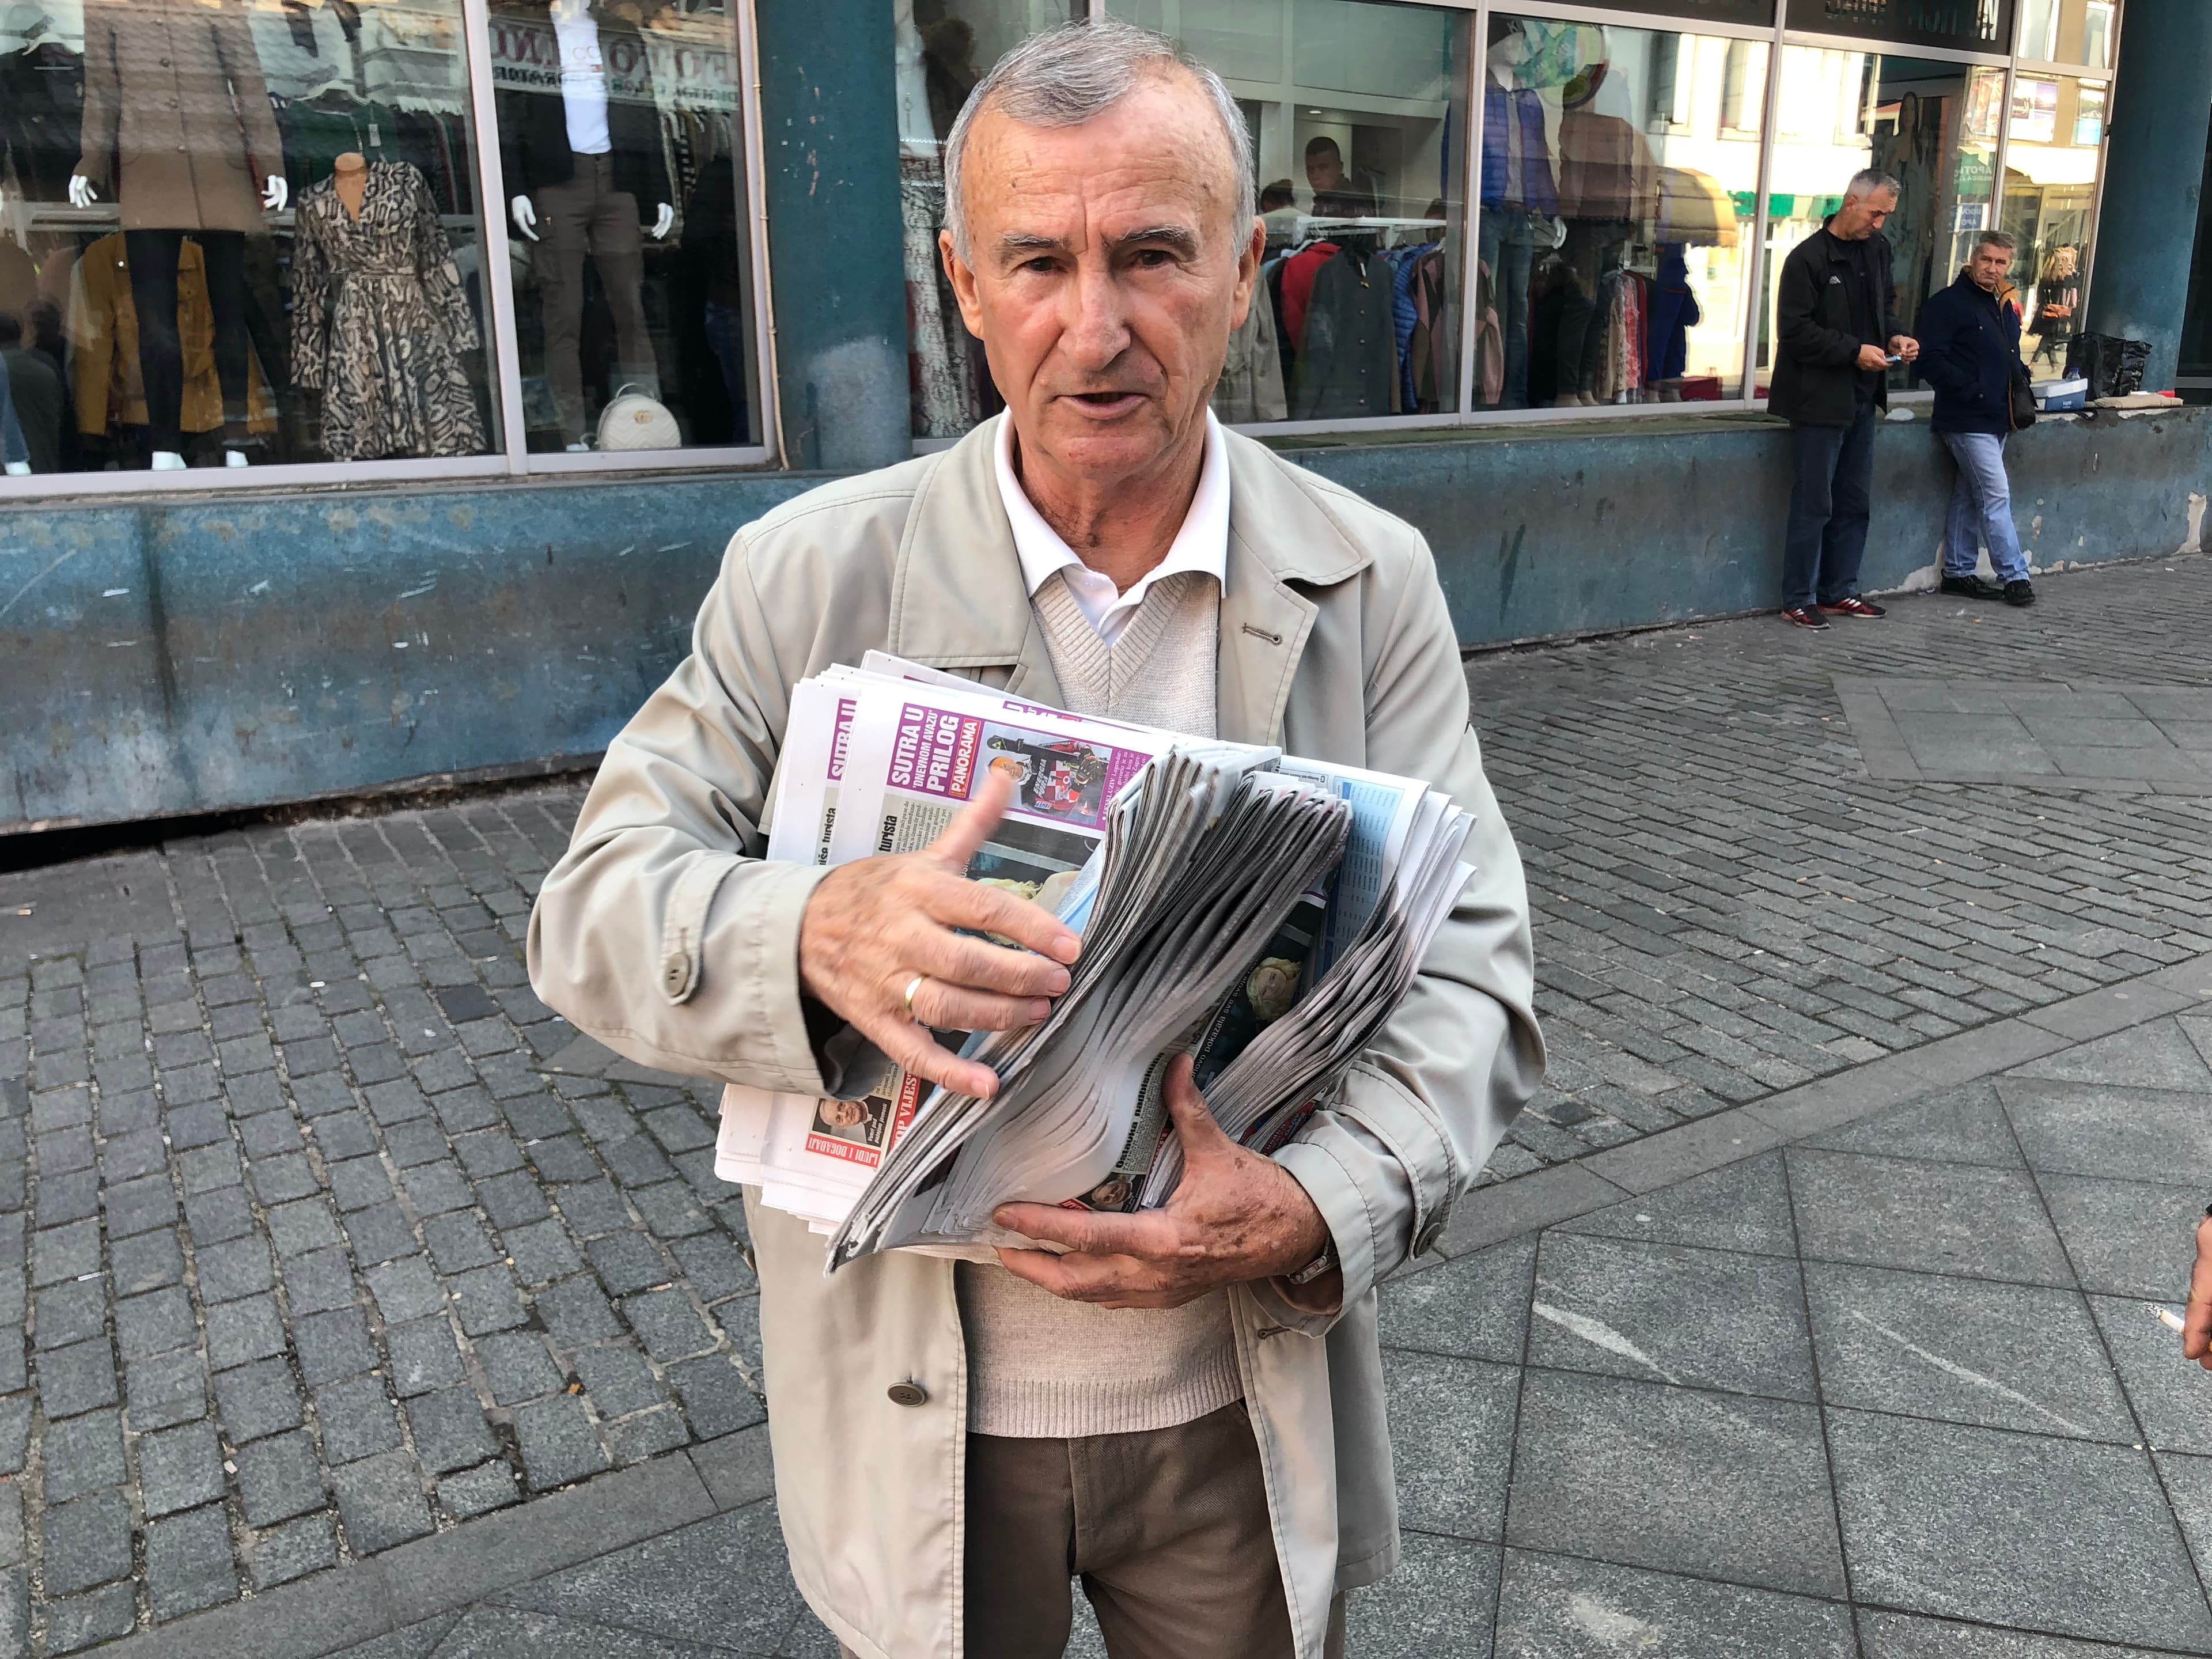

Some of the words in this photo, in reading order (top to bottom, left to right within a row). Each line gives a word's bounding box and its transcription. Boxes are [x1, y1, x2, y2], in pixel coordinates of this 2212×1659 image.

[904, 707, 924, 722] U
[891, 726, 921, 786] SUTRA
[927, 714, 960, 792] PRILOG
[951, 721, 978, 792] PANORAMA
[1033, 759, 1047, 794] ENERGIA
[1038, 775, 1048, 798] PURA
[1103, 778, 1115, 815] EKSKLUZIV
[932, 807, 942, 825] godinu
[878, 815, 897, 853] turista
[902, 824, 911, 848] milijarde
[1204, 1015, 1226, 1053] pokazala
[878, 1103, 889, 1123] javnosti
[874, 1123, 884, 1144] pažnjom
[1115, 1121, 1138, 1169] Ostavka
[853, 1149, 878, 1165] LJUDI
